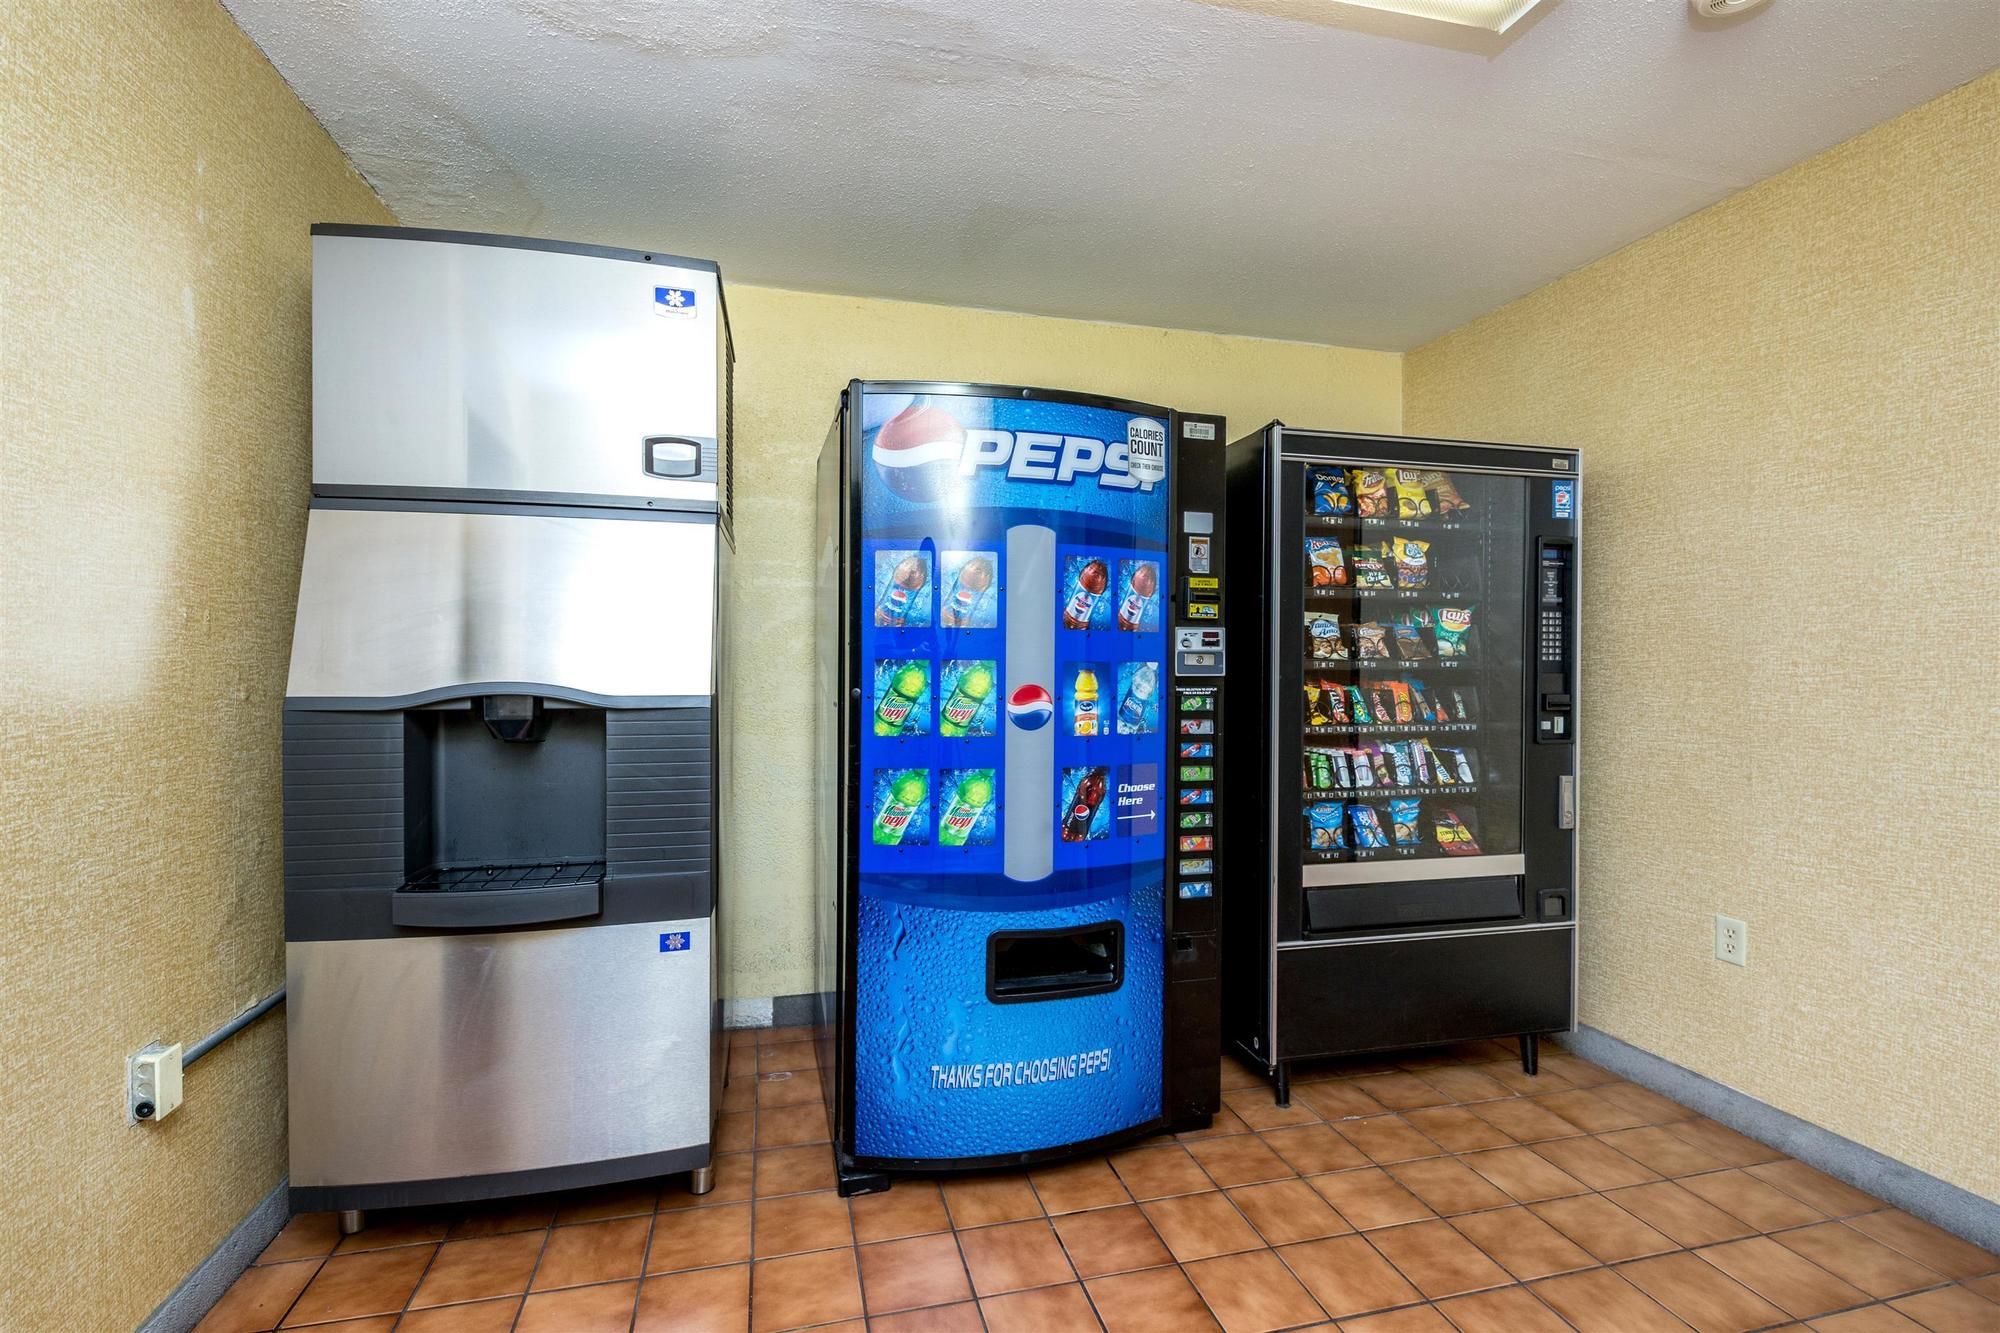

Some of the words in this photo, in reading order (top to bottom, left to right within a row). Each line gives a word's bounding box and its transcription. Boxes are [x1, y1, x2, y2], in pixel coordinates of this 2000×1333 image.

[1130, 427, 1163, 442] CALORIES
[1131, 439, 1163, 457] COUNT
[959, 429, 1154, 491] PEPS
[1442, 610, 1470, 624] Lay's
[1118, 783, 1155, 792] Choose
[1118, 797, 1143, 806] Here
[931, 1065, 982, 1089] THANKS
[985, 1063, 1012, 1087] FOR
[1015, 1055, 1077, 1085] CHOOSING
[1078, 1048, 1112, 1076] PEPSI
